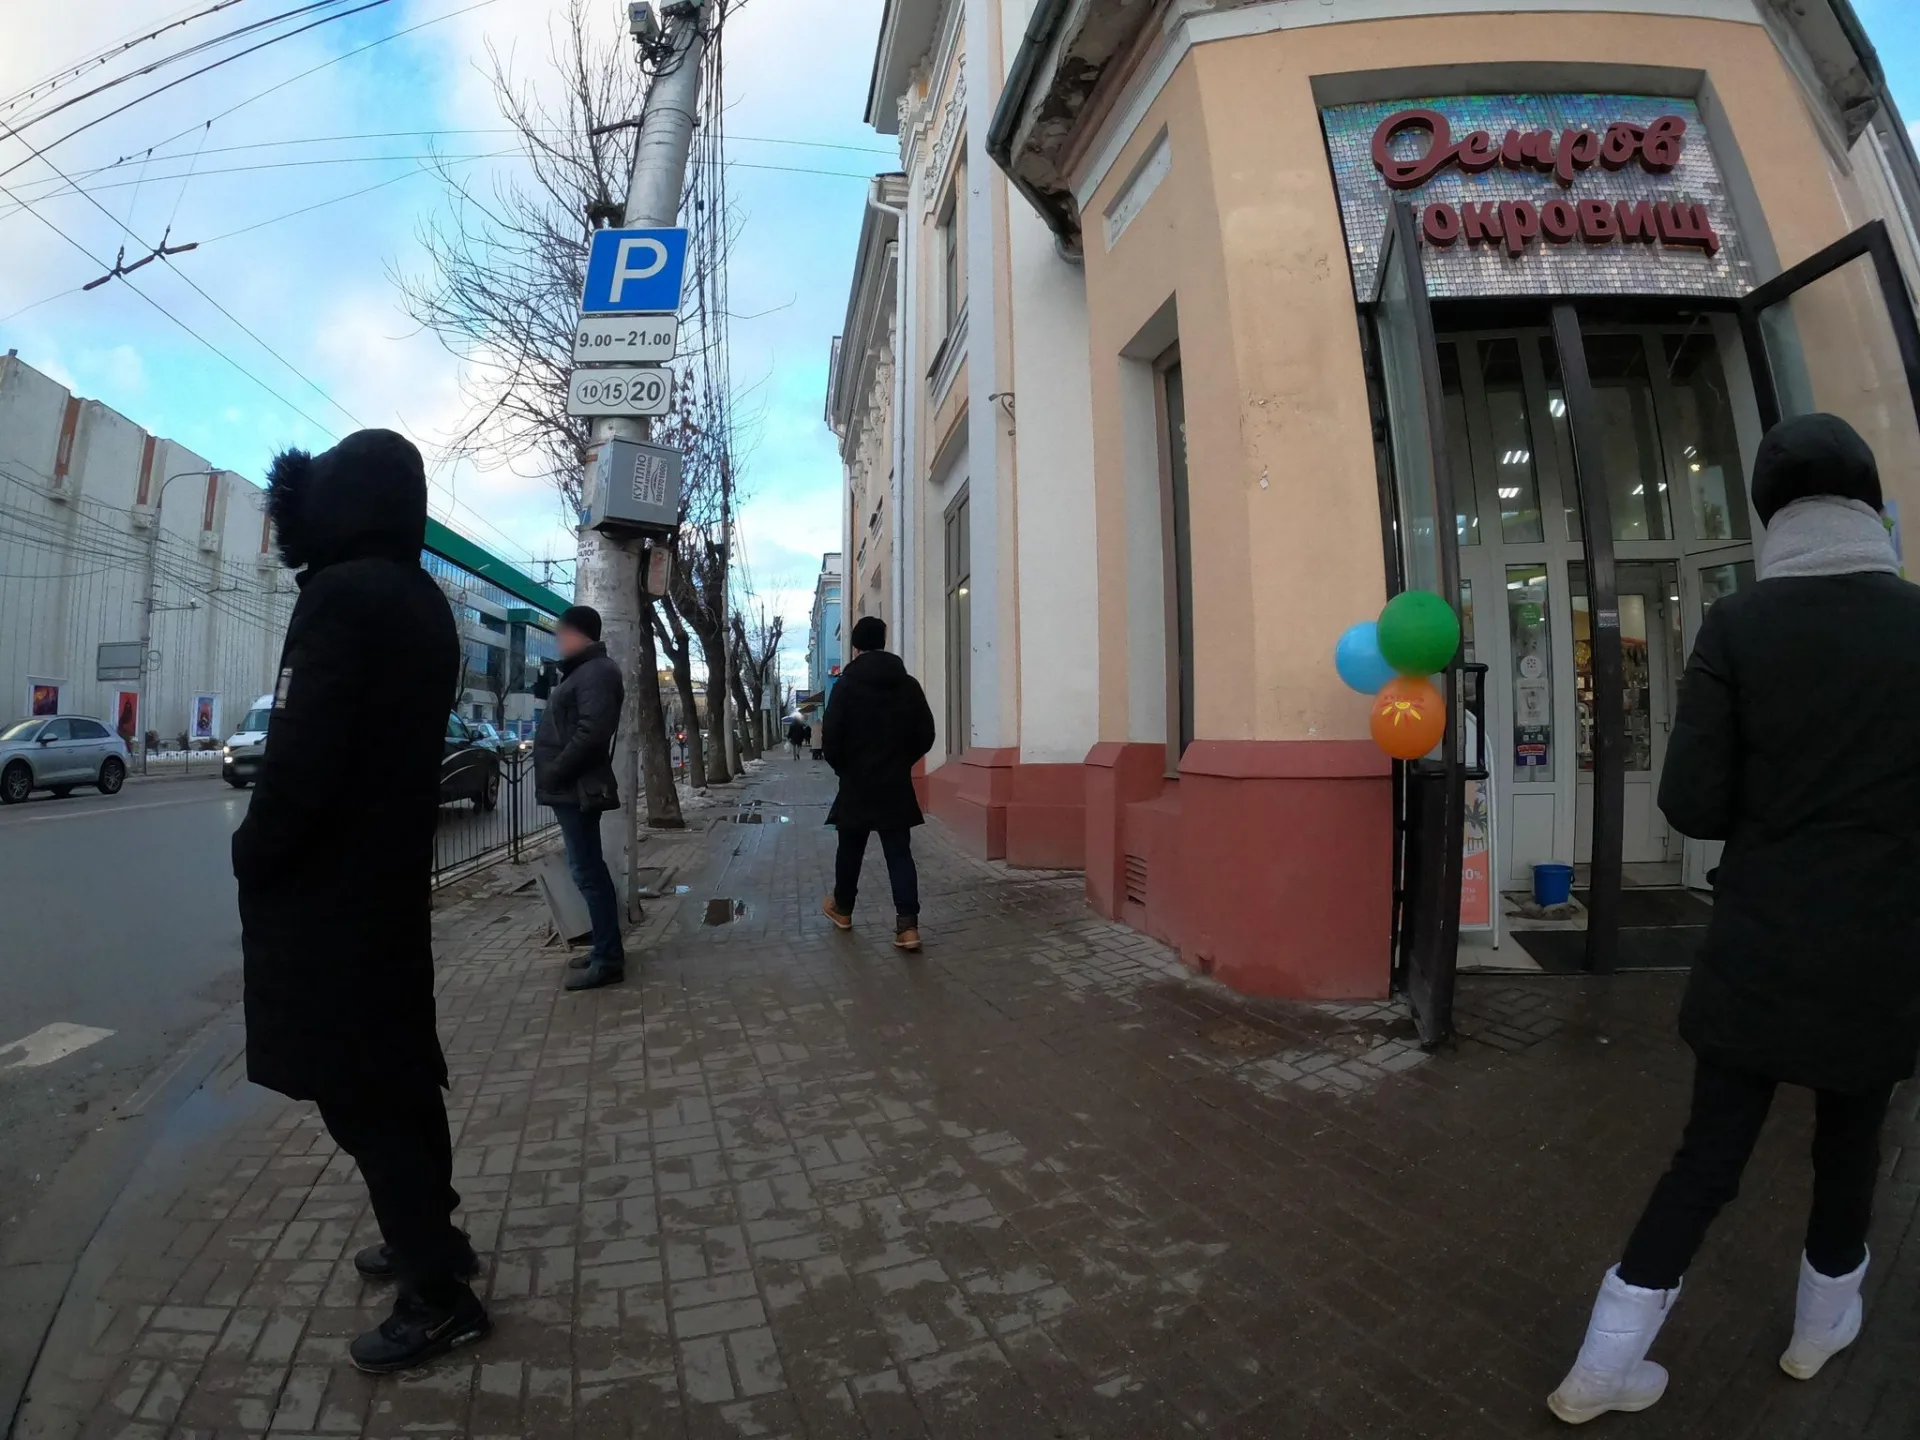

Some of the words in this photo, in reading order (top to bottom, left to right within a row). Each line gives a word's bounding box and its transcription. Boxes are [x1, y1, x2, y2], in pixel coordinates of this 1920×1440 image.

[1371, 109, 1687, 190] Остров
[1410, 198, 1719, 259] окровищ
[608, 237, 669, 303] P
[581, 385, 598, 399] 10
[604, 383, 622, 400] 15
[630, 381, 661, 402] 20
[633, 454, 646, 500] КУПЛЮ
